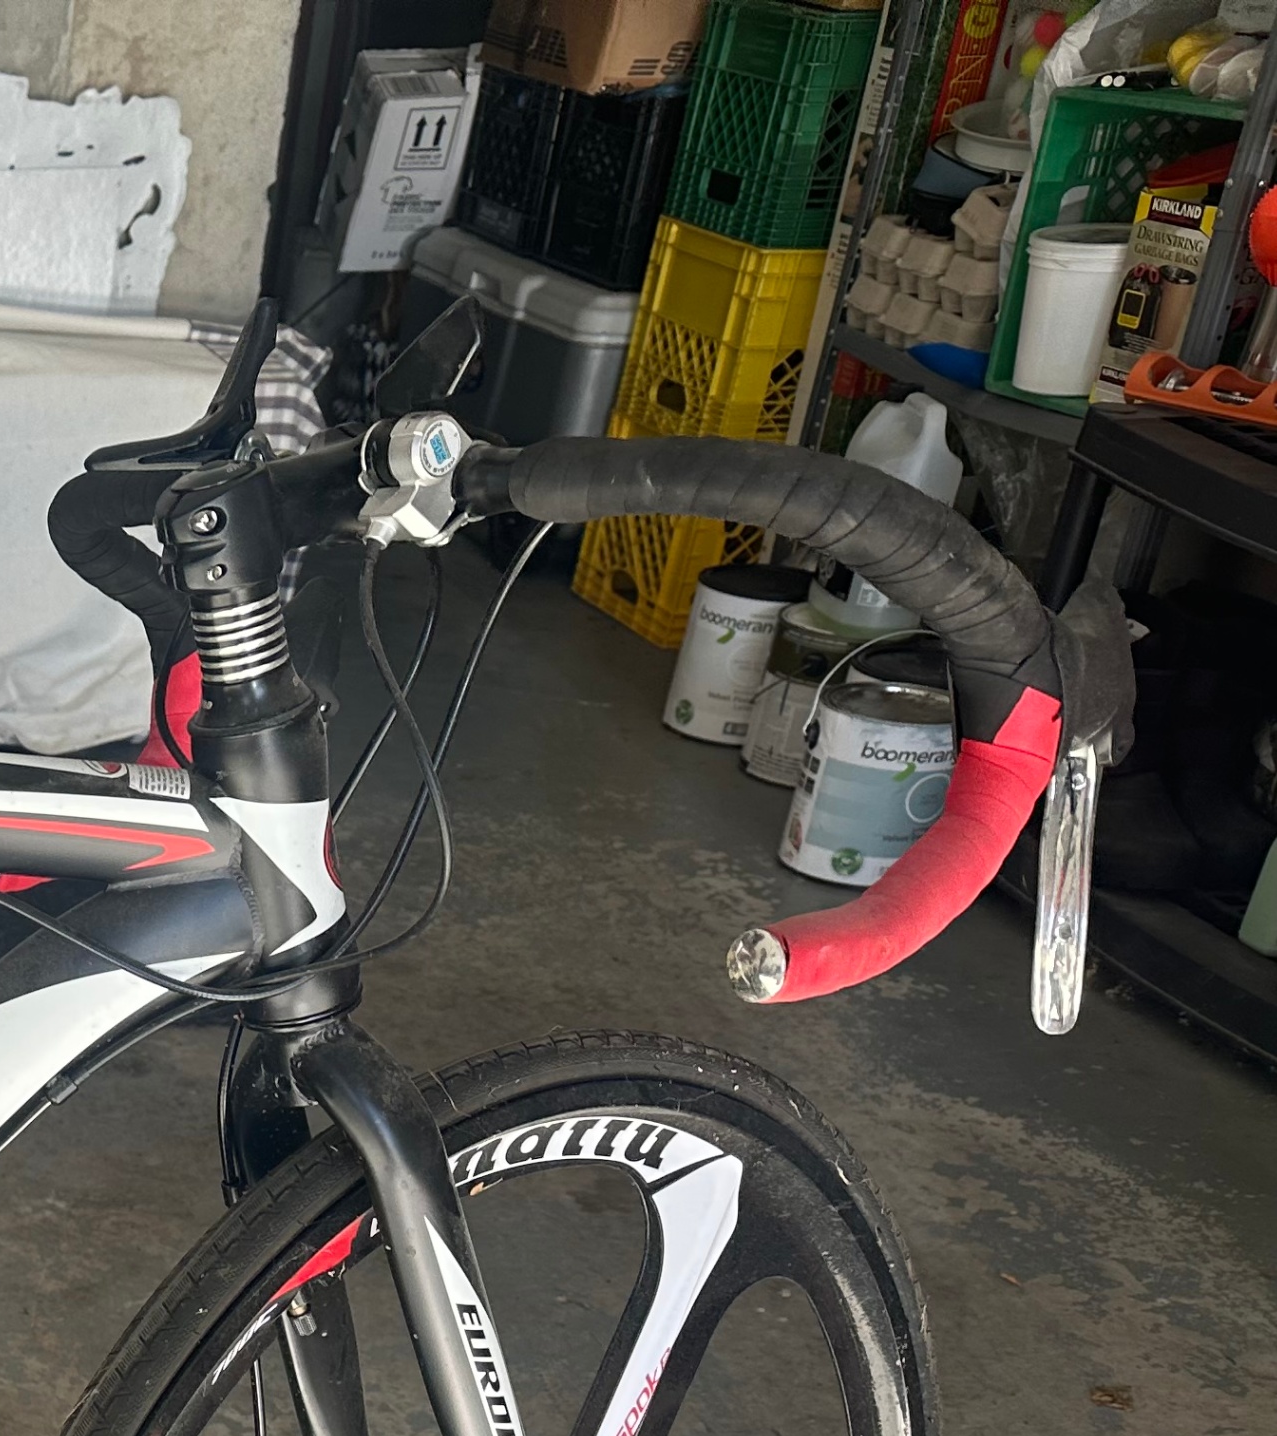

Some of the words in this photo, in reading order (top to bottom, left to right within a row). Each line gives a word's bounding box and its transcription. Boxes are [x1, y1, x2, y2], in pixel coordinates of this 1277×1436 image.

[1151, 197, 1203, 220] KIRKLAND
[1136, 224, 1204, 254] DRAWSTRING
[699, 604, 774, 635] boomeran
